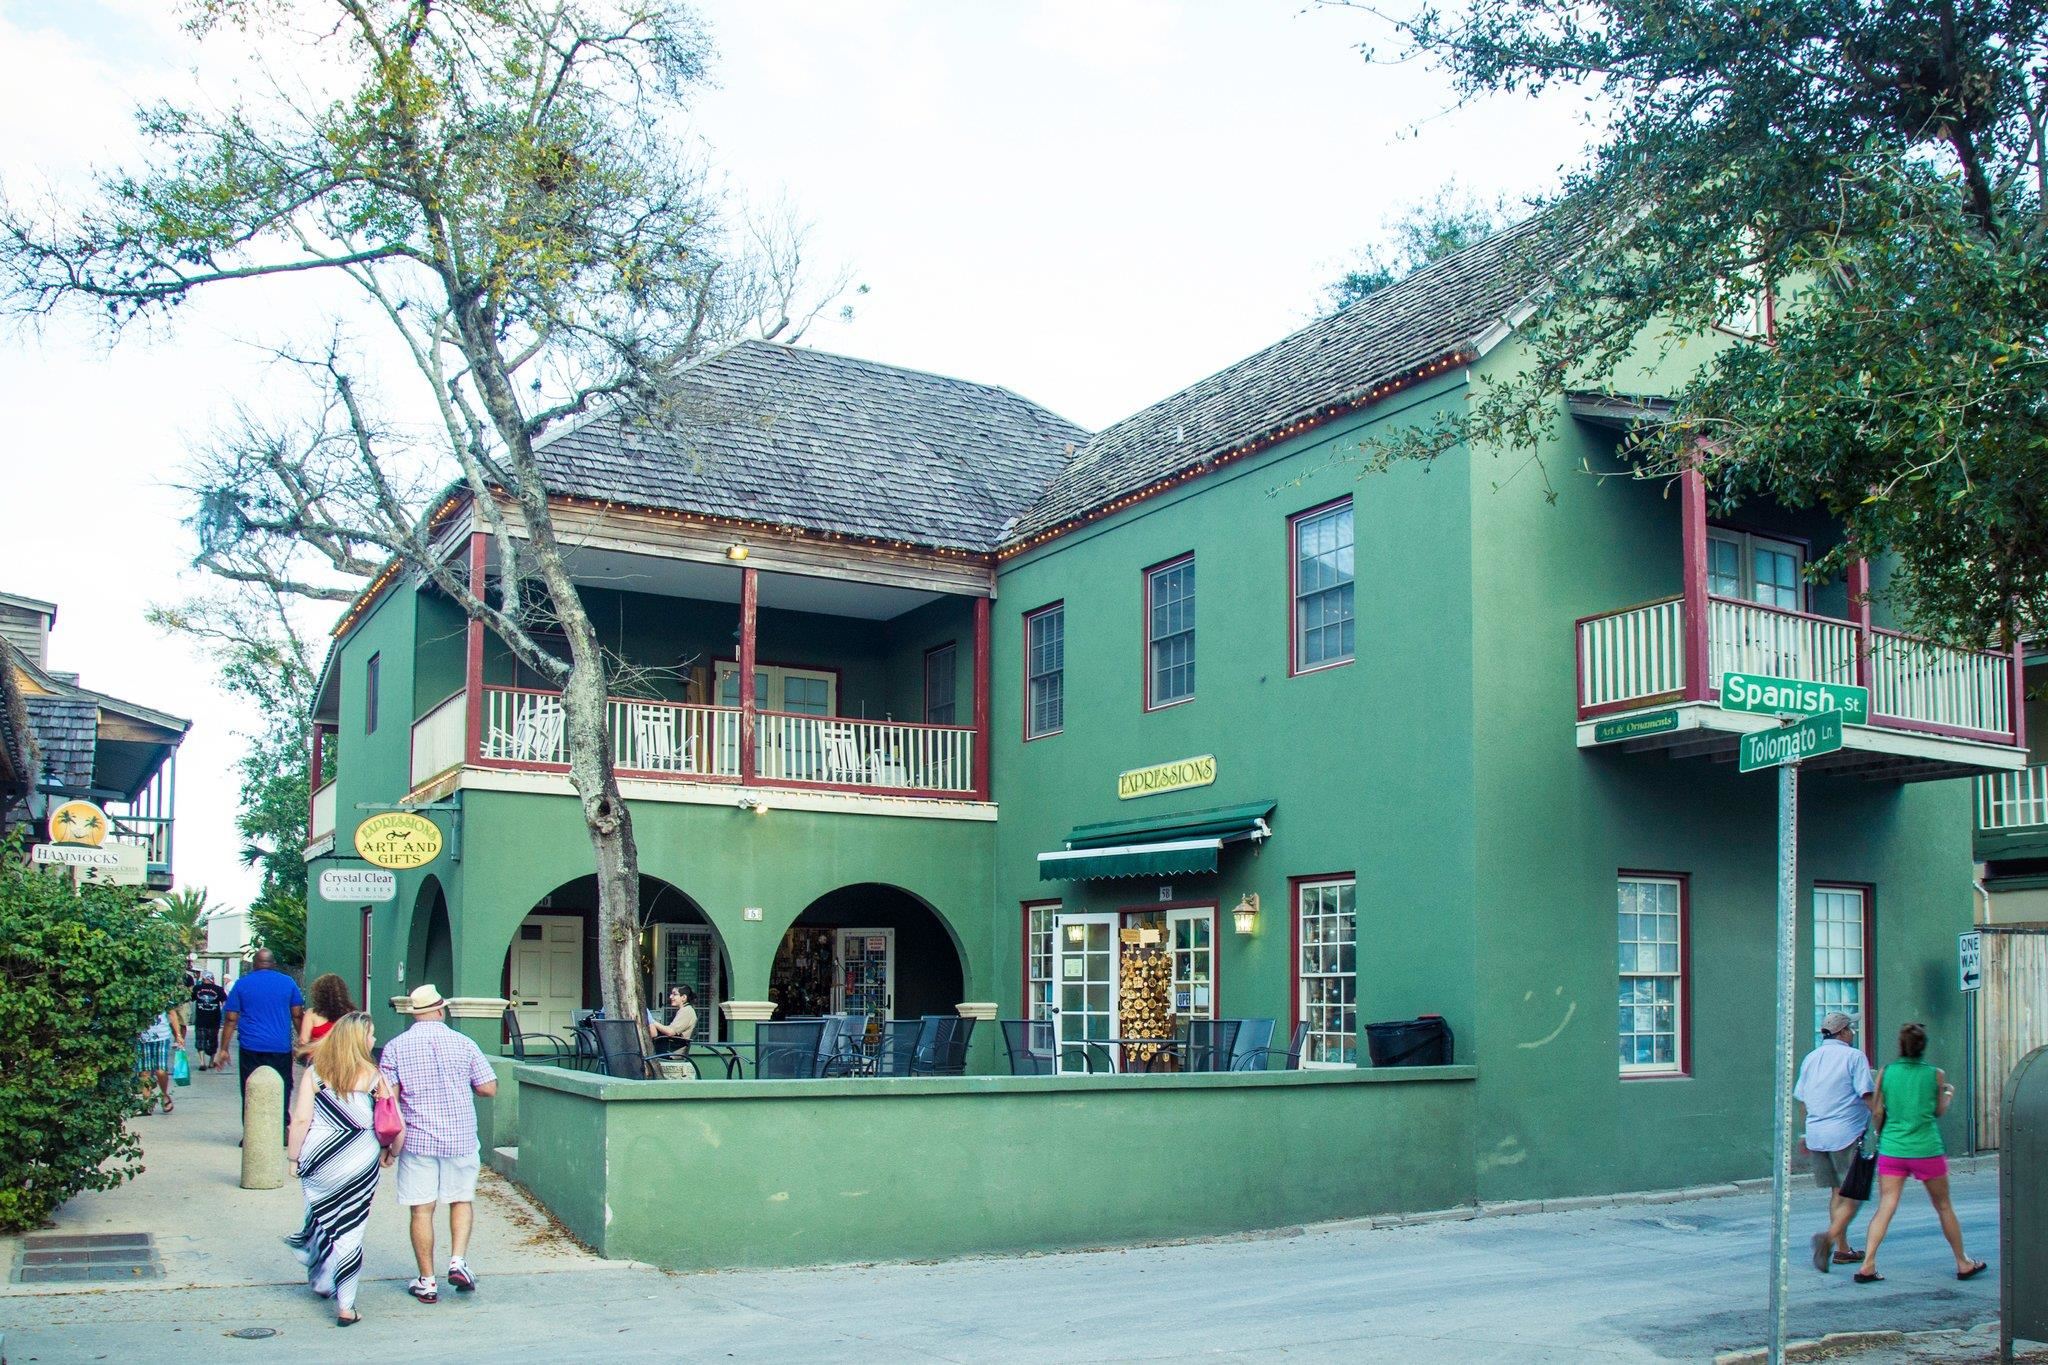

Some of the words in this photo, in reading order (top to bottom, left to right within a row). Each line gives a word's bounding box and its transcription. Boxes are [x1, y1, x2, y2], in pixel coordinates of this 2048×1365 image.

[1727, 676, 1835, 711] Spanish
[1626, 717, 1672, 732] Ornaments
[1749, 725, 1816, 764] Tolomato
[1120, 759, 1213, 795] EXPRESSIONS
[361, 815, 438, 841] EXPRESSIONS
[362, 842, 397, 853] ART
[403, 842, 437, 853] AND
[37, 848, 119, 864] HAMMOCKS
[378, 854, 421, 864] GIFTS
[324, 873, 361, 885] Crystal
[365, 873, 392, 883] Clear
[1961, 937, 1979, 952] ONE
[1961, 953, 1979, 968] WAY
